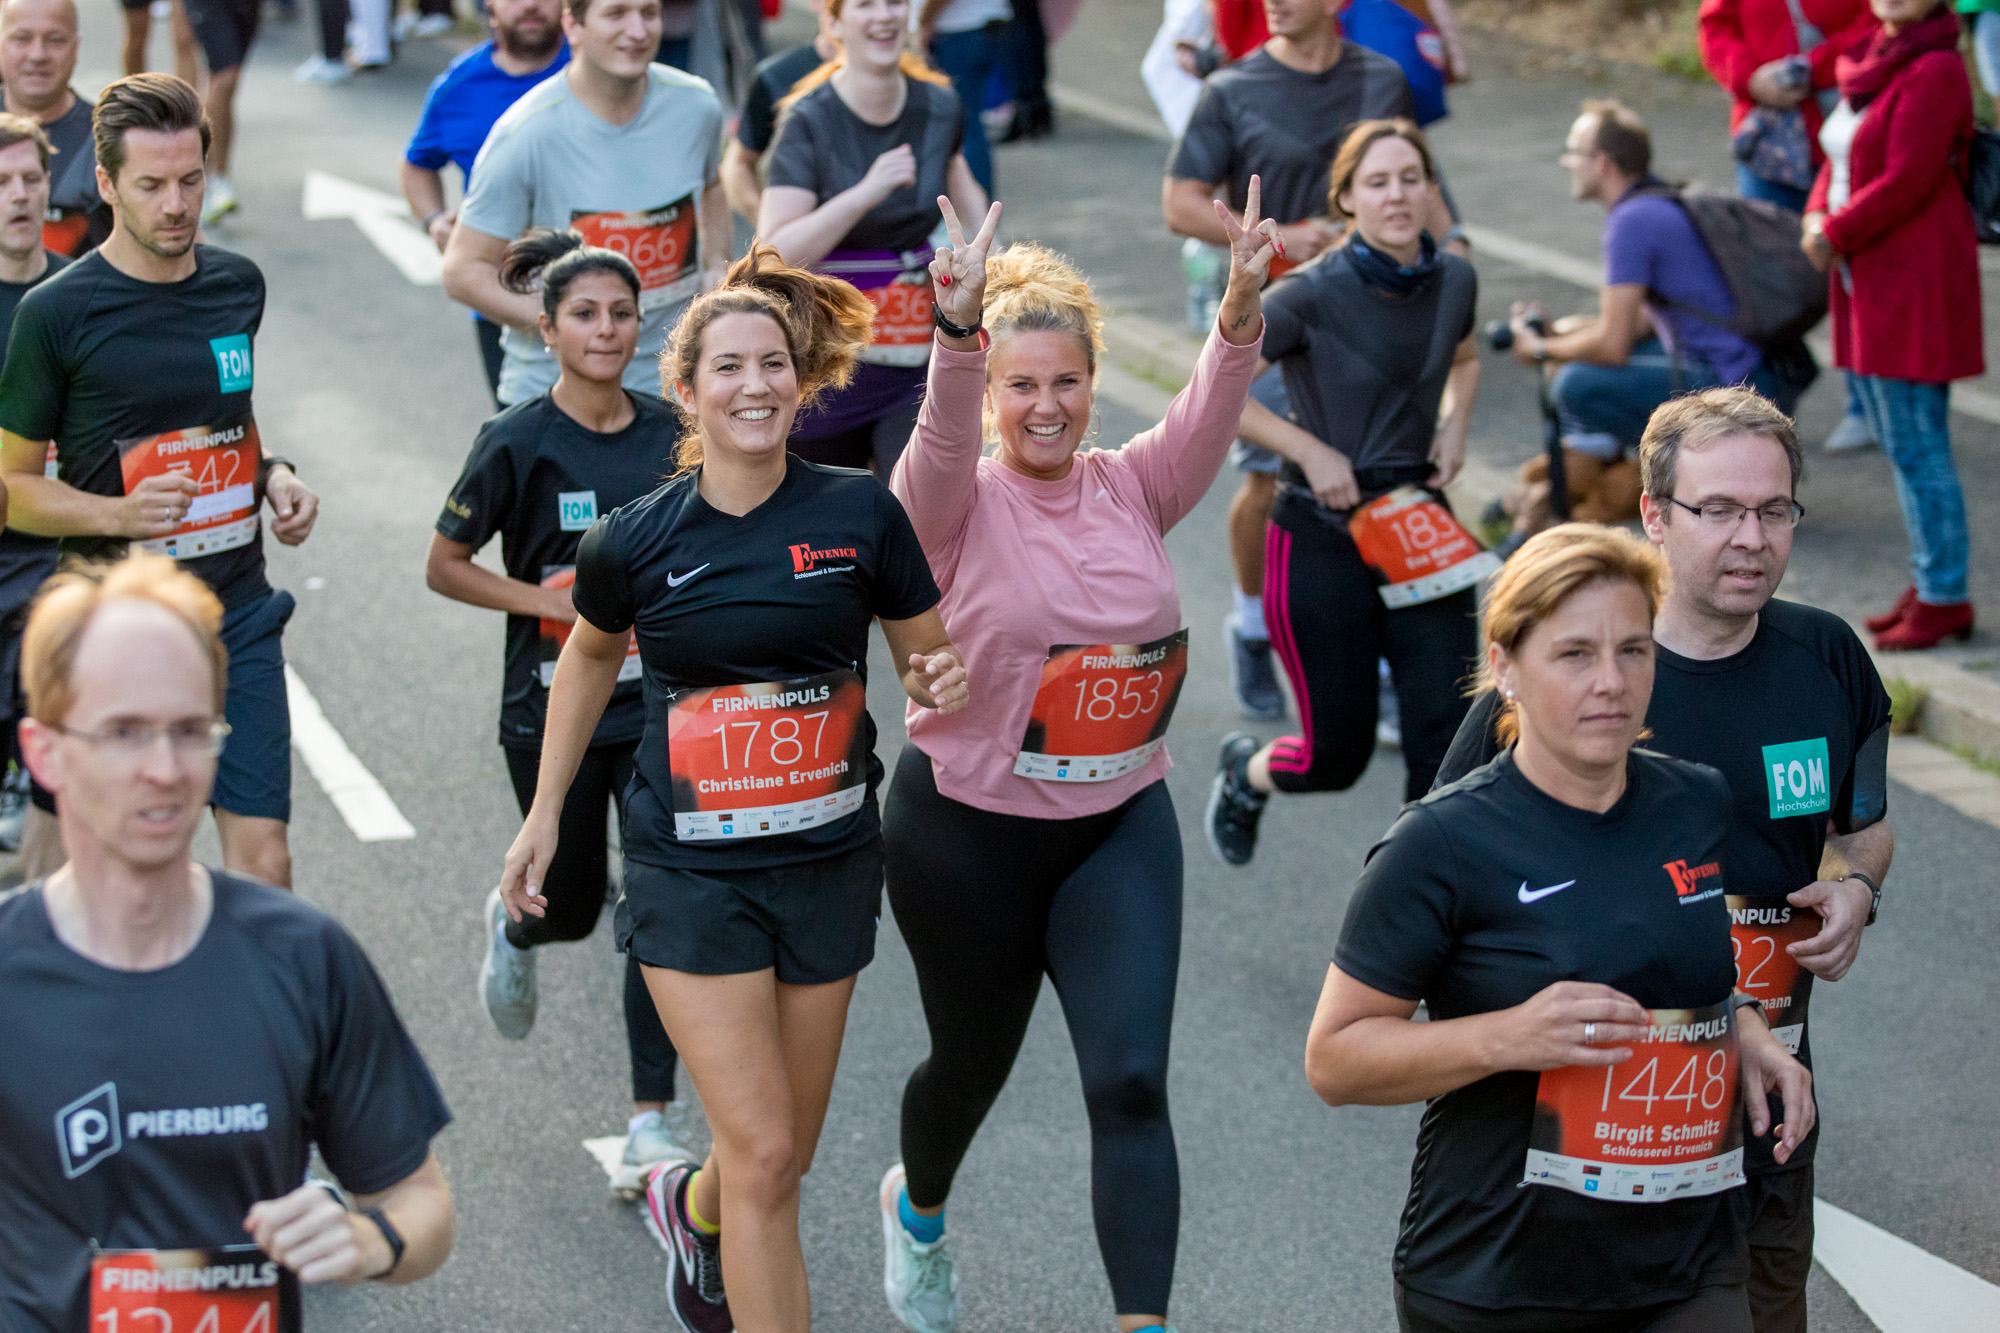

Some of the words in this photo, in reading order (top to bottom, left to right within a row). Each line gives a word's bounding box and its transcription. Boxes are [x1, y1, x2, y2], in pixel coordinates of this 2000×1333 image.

[219, 349, 251, 379] FOM
[157, 425, 244, 457] FIRMENPULS
[563, 501, 593, 520] FOM
[788, 543, 857, 573] ERVENICH
[1082, 646, 1167, 669] FIRMENPULS
[712, 685, 830, 713] FIRMENPULS
[1075, 670, 1163, 721] 1853
[713, 711, 829, 770] 1787
[698, 773, 784, 794] Christiane
[789, 760, 849, 785] Ervenich
[1772, 757, 1826, 801] FOM
[1777, 797, 1826, 812] Hochschule
[1727, 907, 1791, 925] NPULS
[1755, 995, 1792, 1011] mann
[1641, 1016, 1727, 1043] MENPULS
[1600, 1049, 1726, 1115] 1448
[126, 1103, 269, 1138] PIERBURG
[1594, 1122, 1654, 1145] Birgit
[1660, 1120, 1720, 1142] Schmitz
[1601, 1143, 1671, 1157] Schlosserei
[1674, 1140, 1713, 1155] Ervenich
[102, 1263, 279, 1292] FIRMENPULS
